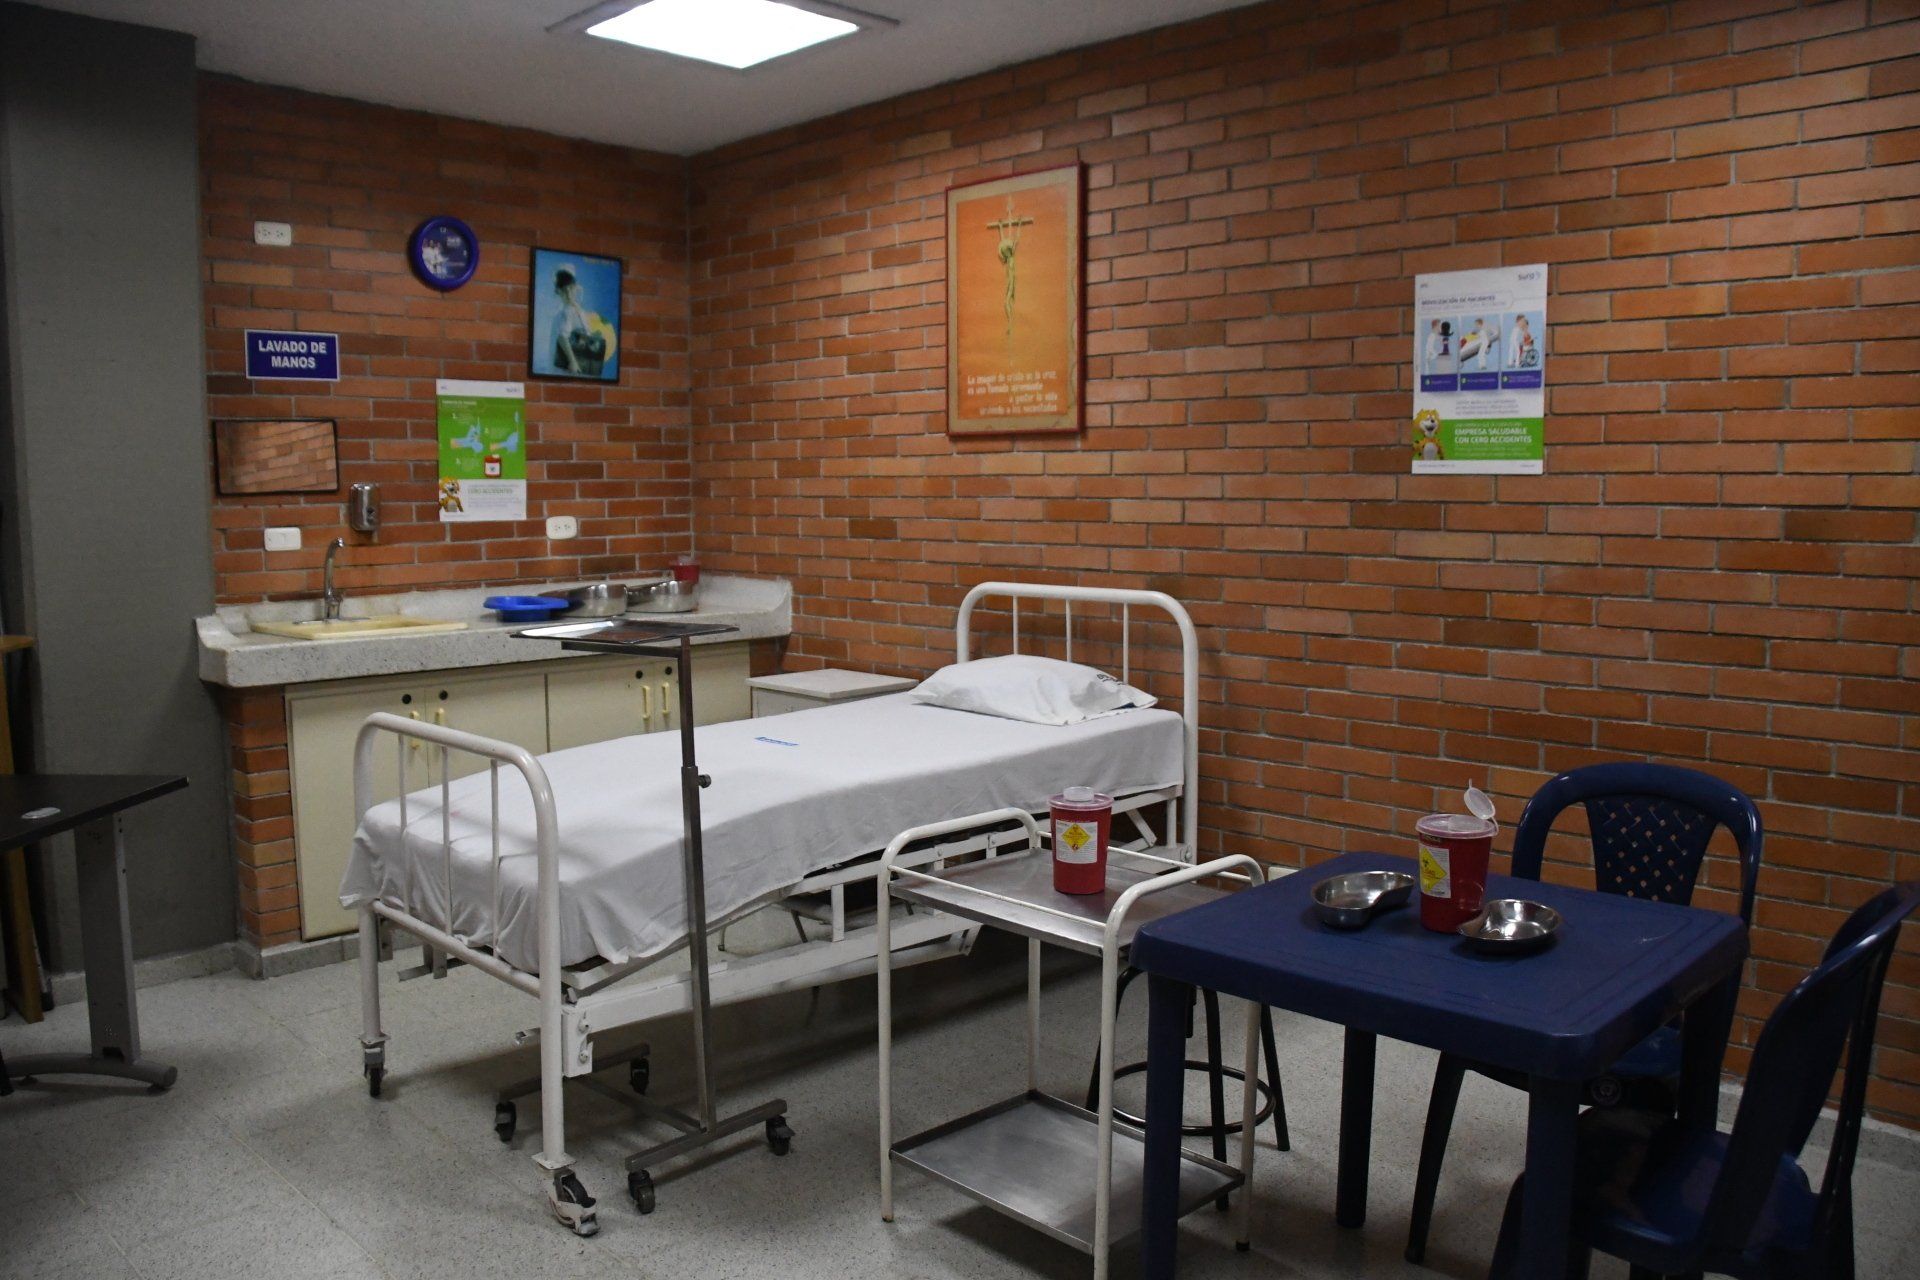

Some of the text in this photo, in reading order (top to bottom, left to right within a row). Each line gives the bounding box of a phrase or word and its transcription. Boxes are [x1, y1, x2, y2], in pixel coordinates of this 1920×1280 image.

[258, 339, 327, 354] LAVADO DE
[271, 355, 316, 369] MANOS
[1488, 426, 1528, 435] SALUDABLE
[1489, 434, 1532, 443] ACCIDENTES
